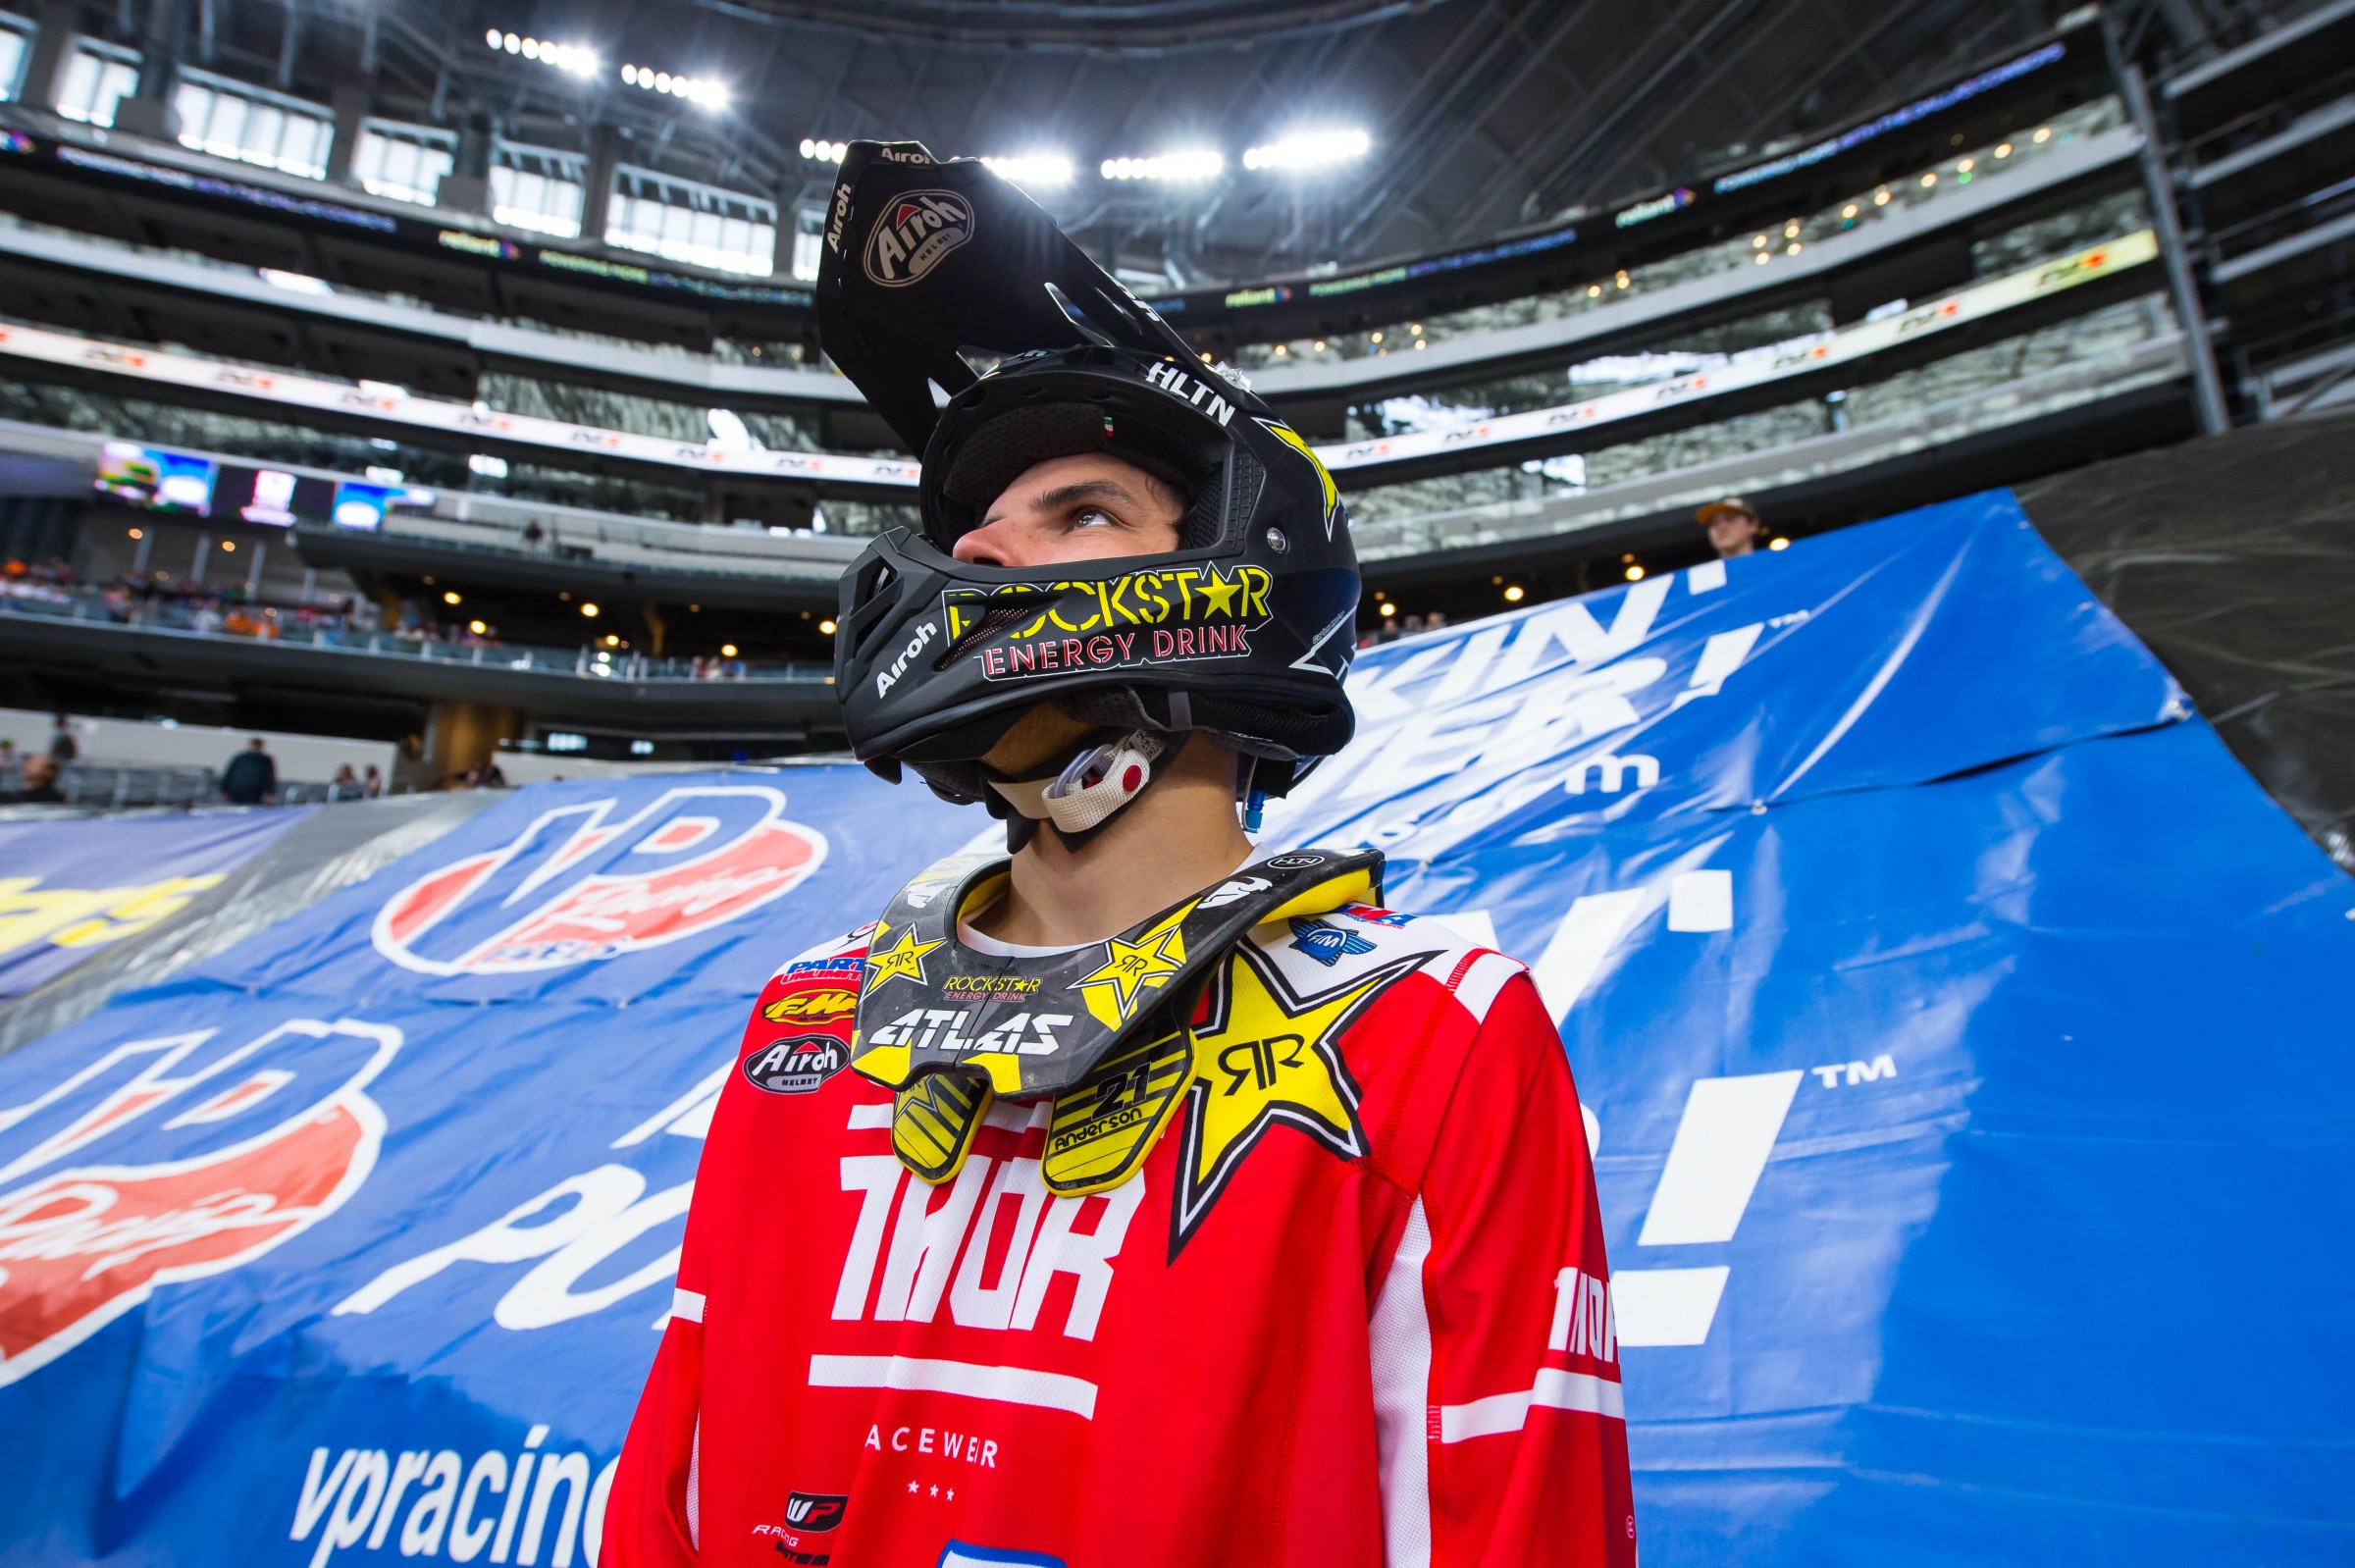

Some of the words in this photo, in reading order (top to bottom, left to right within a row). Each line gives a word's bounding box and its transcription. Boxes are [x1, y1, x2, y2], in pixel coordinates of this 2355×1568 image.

[827, 183, 852, 254] Airoh
[878, 196, 968, 280] Airoh
[919, 233, 953, 261] HELMET
[1144, 360, 1236, 428] HLTN
[875, 620, 938, 699] Airoh
[984, 631, 1136, 676] ENERGY
[1153, 623, 1248, 660] DRINK
[781, 969, 863, 985] UNLIMIT
[786, 958, 865, 974] PART
[945, 991, 990, 1001] ENERGY
[992, 991, 1027, 1001] DRINK
[868, 1008, 1074, 1057] ATLAS
[751, 1041, 838, 1072] Airoh
[1811, 1054, 1898, 1089] TM
[781, 1077, 818, 1087] HELMET
[1091, 1061, 1153, 1122] 21
[1054, 1106, 1143, 1152] Anderson
[830, 1154, 1146, 1342] THOR
[864, 1424, 999, 1469] ACEWER
[786, 1497, 842, 1524] WP
